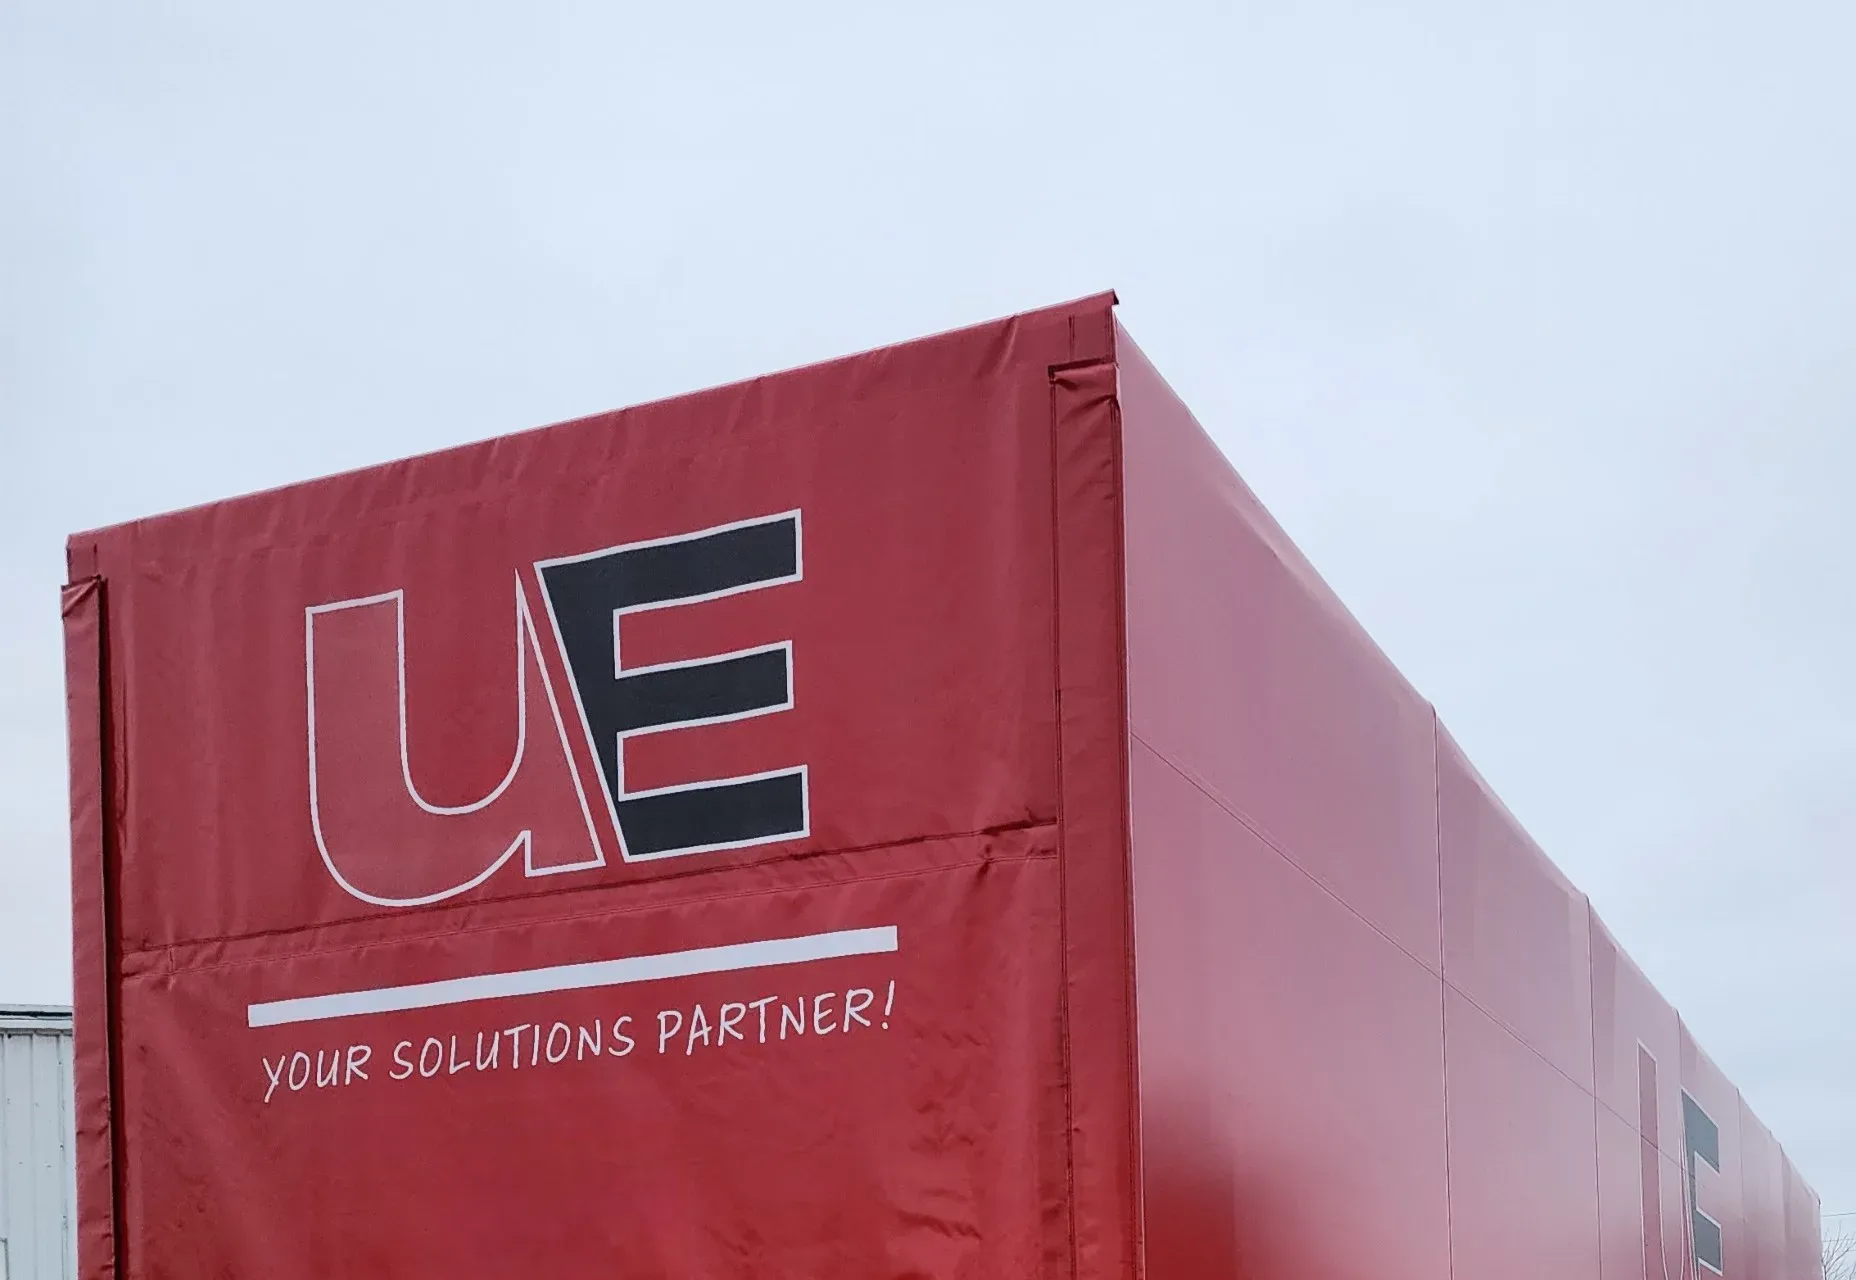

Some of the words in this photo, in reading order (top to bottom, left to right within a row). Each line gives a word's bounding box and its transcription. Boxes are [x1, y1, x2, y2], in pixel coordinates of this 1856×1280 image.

[306, 508, 811, 907] UE
[262, 1045, 372, 1102] YOUR
[389, 1016, 636, 1081] SOLUTIONS
[657, 980, 896, 1056] PARTNER!
